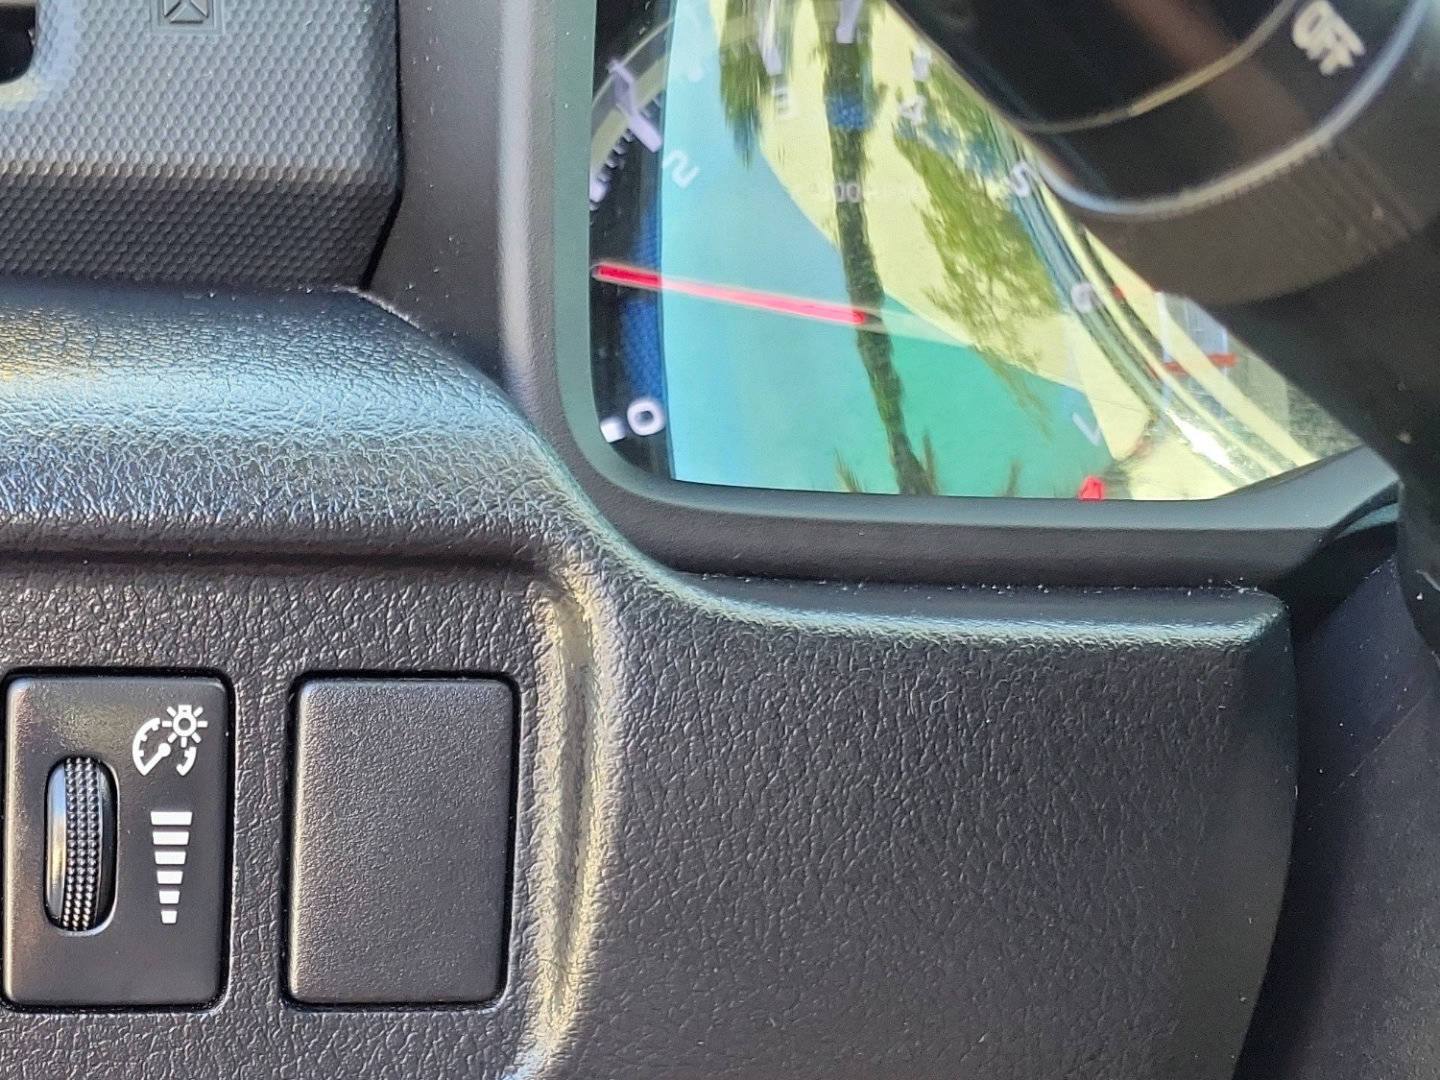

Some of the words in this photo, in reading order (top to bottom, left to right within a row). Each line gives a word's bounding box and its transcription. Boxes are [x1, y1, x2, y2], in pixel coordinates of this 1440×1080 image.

[1292, 0, 1366, 76] OFF
[662, 150, 700, 189] 2
[627, 399, 665, 436] 0
